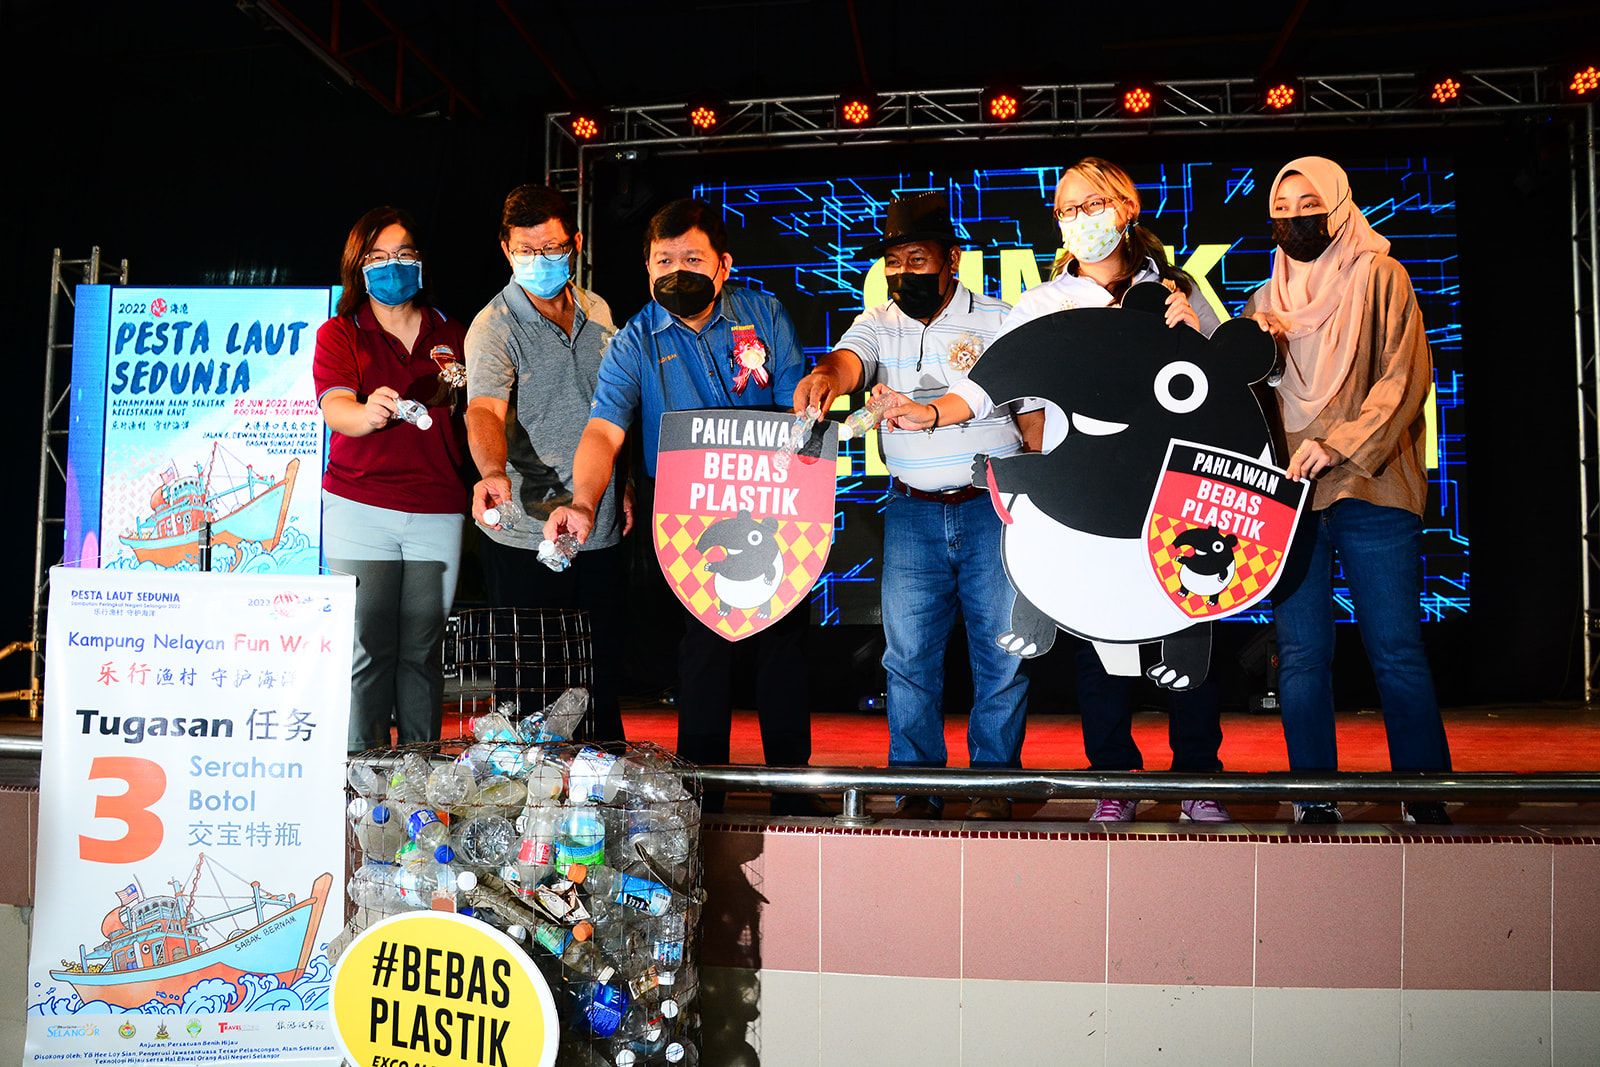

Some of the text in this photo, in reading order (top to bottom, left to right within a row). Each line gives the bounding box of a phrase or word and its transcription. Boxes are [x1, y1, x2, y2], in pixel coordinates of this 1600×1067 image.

[118, 303, 146, 314] 2022
[115, 319, 308, 355] PESTA LAUT
[111, 358, 250, 395] SEDUNIA
[234, 399, 245, 408] 26
[247, 399, 263, 408] JUN
[266, 399, 288, 408] 2022
[691, 417, 804, 448] PAHLAWA
[703, 452, 788, 483] BEBAS
[1192, 452, 1280, 495] PAHLAWAN
[690, 482, 800, 516] PLASTIK
[1196, 479, 1263, 516] BEBAS
[1180, 498, 1266, 541] PLASTIK
[71, 590, 180, 602] PESTA LAUT SEDUNIA
[68, 631, 332, 654] Kampung Nelayan Fun Wk
[76, 707, 317, 744] Tugasan 任务
[189, 755, 303, 779] Serahan
[78, 756, 167, 864] 3
[188, 789, 256, 812] Botol
[187, 820, 302, 848] 交宝特瓶
[235, 916, 297, 952] SABAK BERNAM
[372, 941, 511, 1009] #BEBAS
[47, 1024, 100, 1038] SELANGOR
[369, 997, 511, 1067] PLASTIK
